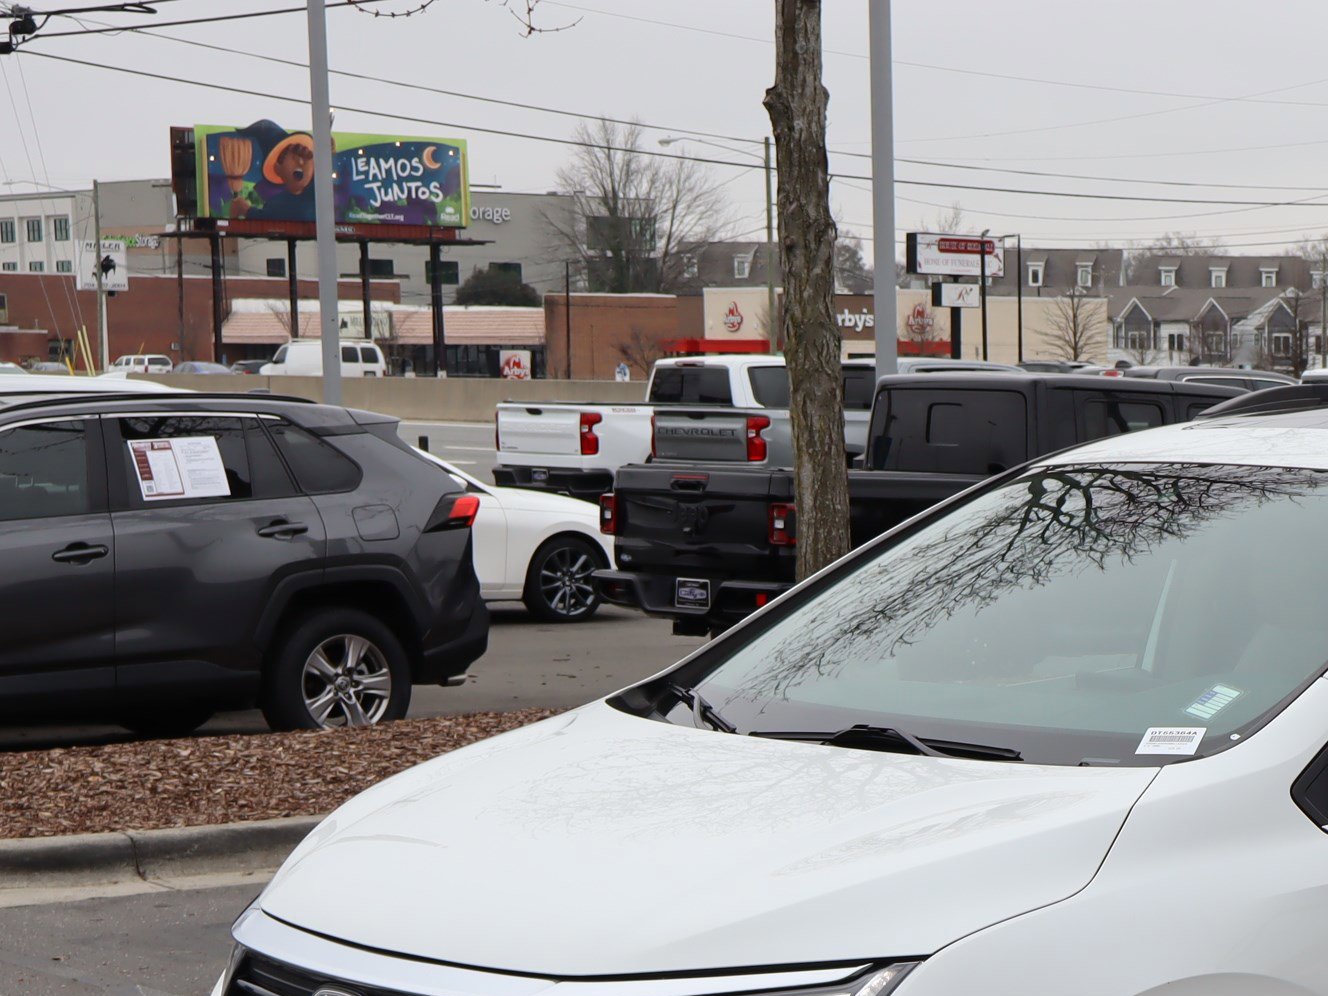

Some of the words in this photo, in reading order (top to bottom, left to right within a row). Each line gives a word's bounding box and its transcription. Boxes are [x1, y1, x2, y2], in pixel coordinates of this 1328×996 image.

[351, 157, 424, 182] LEAMOS
[470, 206, 512, 223] orage
[837, 308, 875, 332] rby's
[657, 427, 738, 438] CHEVROLET
